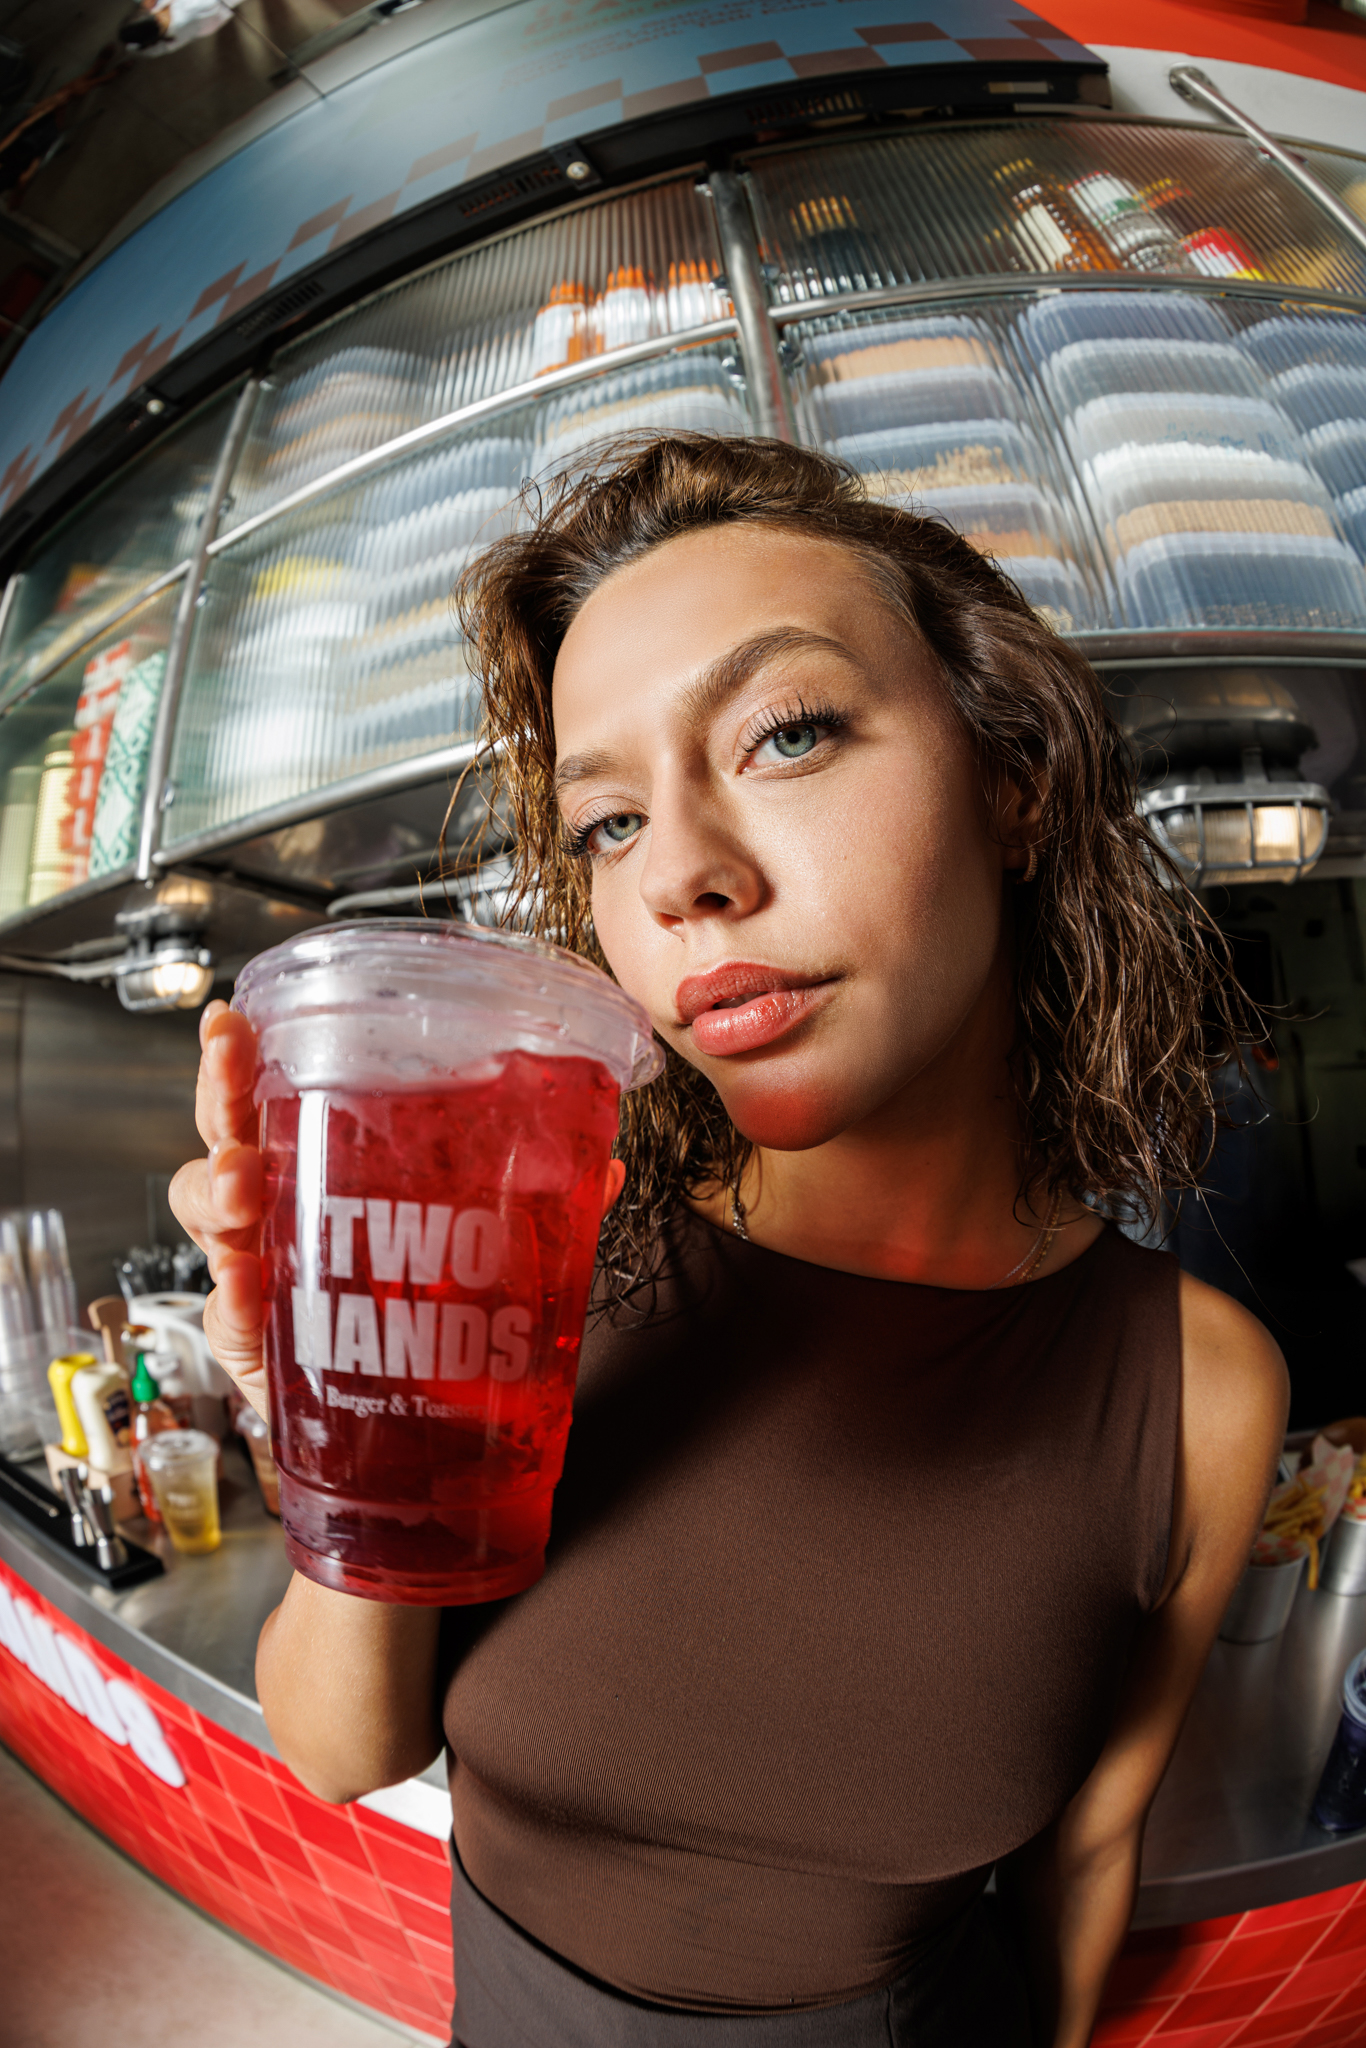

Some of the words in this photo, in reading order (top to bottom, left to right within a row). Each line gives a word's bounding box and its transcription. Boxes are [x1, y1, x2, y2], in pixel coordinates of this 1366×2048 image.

[323, 1195, 504, 1289] TWO
[291, 1286, 533, 1383] HANDS
[325, 1384, 388, 1418] Burger
[388, 1392, 410, 1417] &
